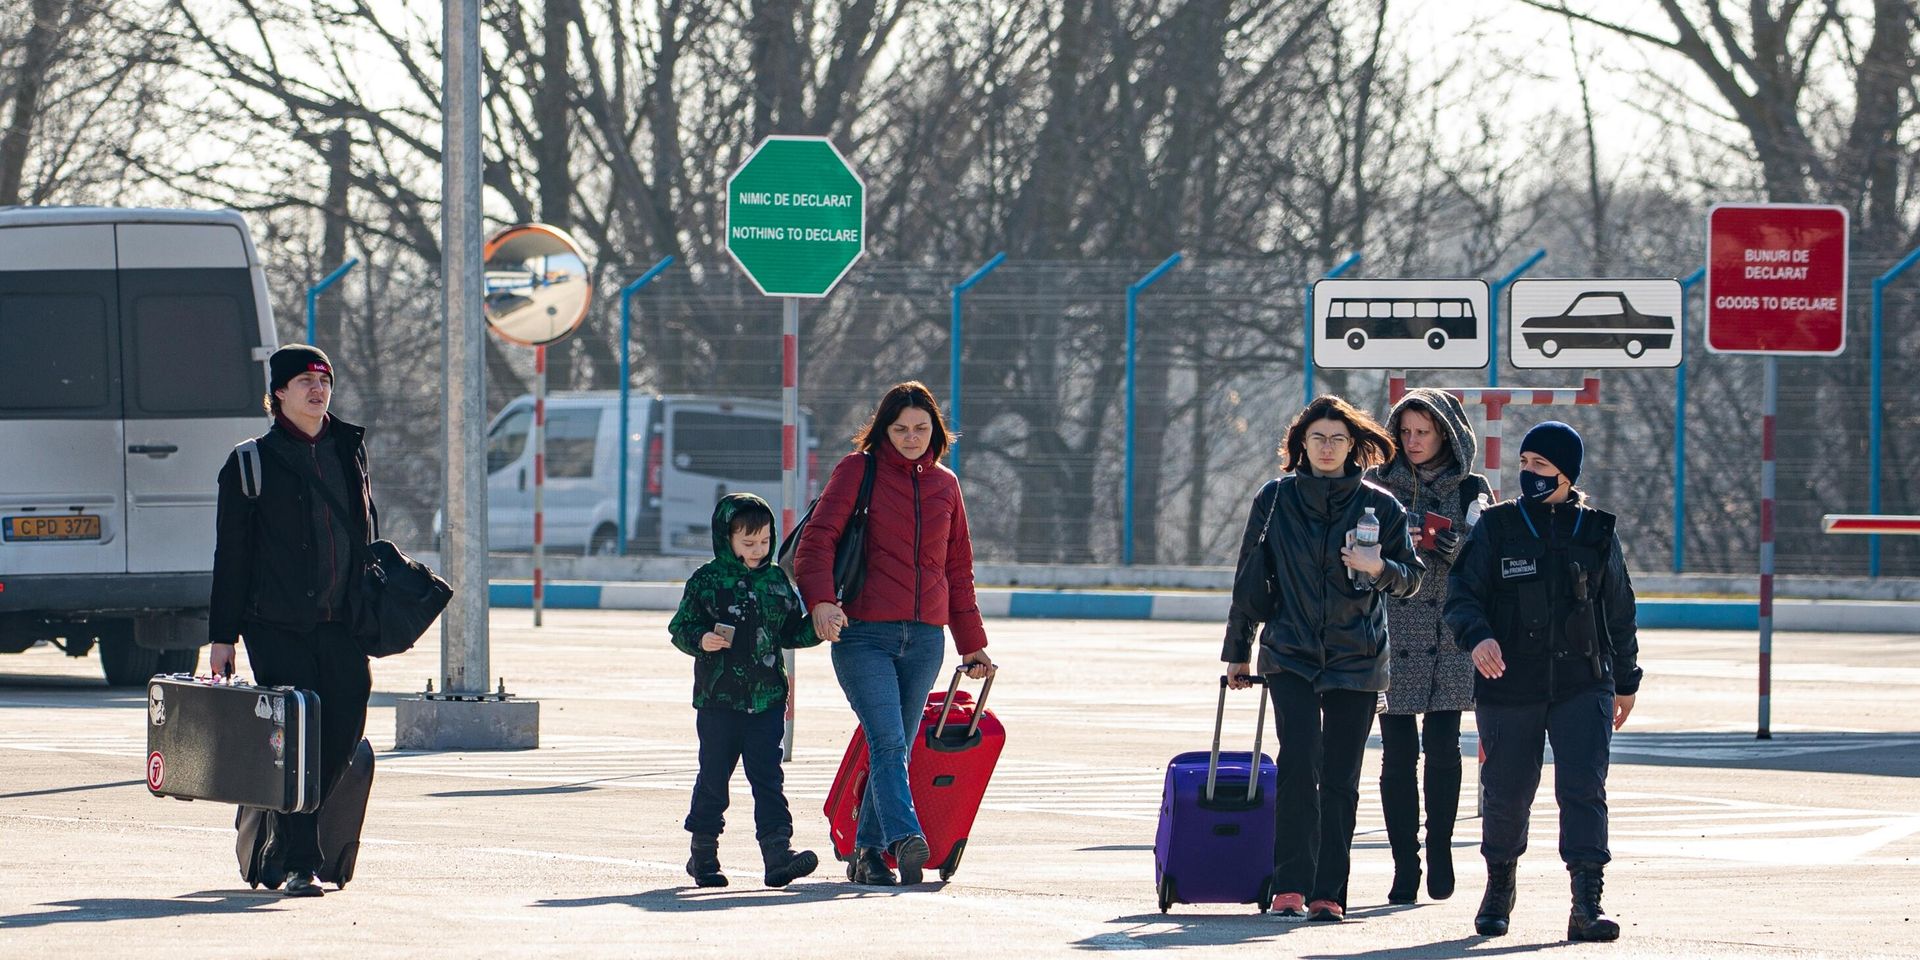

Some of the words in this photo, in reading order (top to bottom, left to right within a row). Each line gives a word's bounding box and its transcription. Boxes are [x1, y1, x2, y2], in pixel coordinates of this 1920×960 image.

[739, 192, 771, 206] NIMIC
[774, 193, 790, 206] DE
[793, 194, 853, 207] DECLARAT
[732, 226, 784, 240] NOTHING
[787, 227, 802, 240] TO
[805, 228, 858, 242] DECLARE
[1744, 249, 1790, 263] BUNURI
[1792, 250, 1810, 263] DE
[1745, 266, 1808, 280] DECLARAT
[1716, 296, 1760, 310] GOODS
[1762, 297, 1778, 310] TO
[1781, 297, 1837, 311] DECLARE
[64, 518, 92, 534] 377
